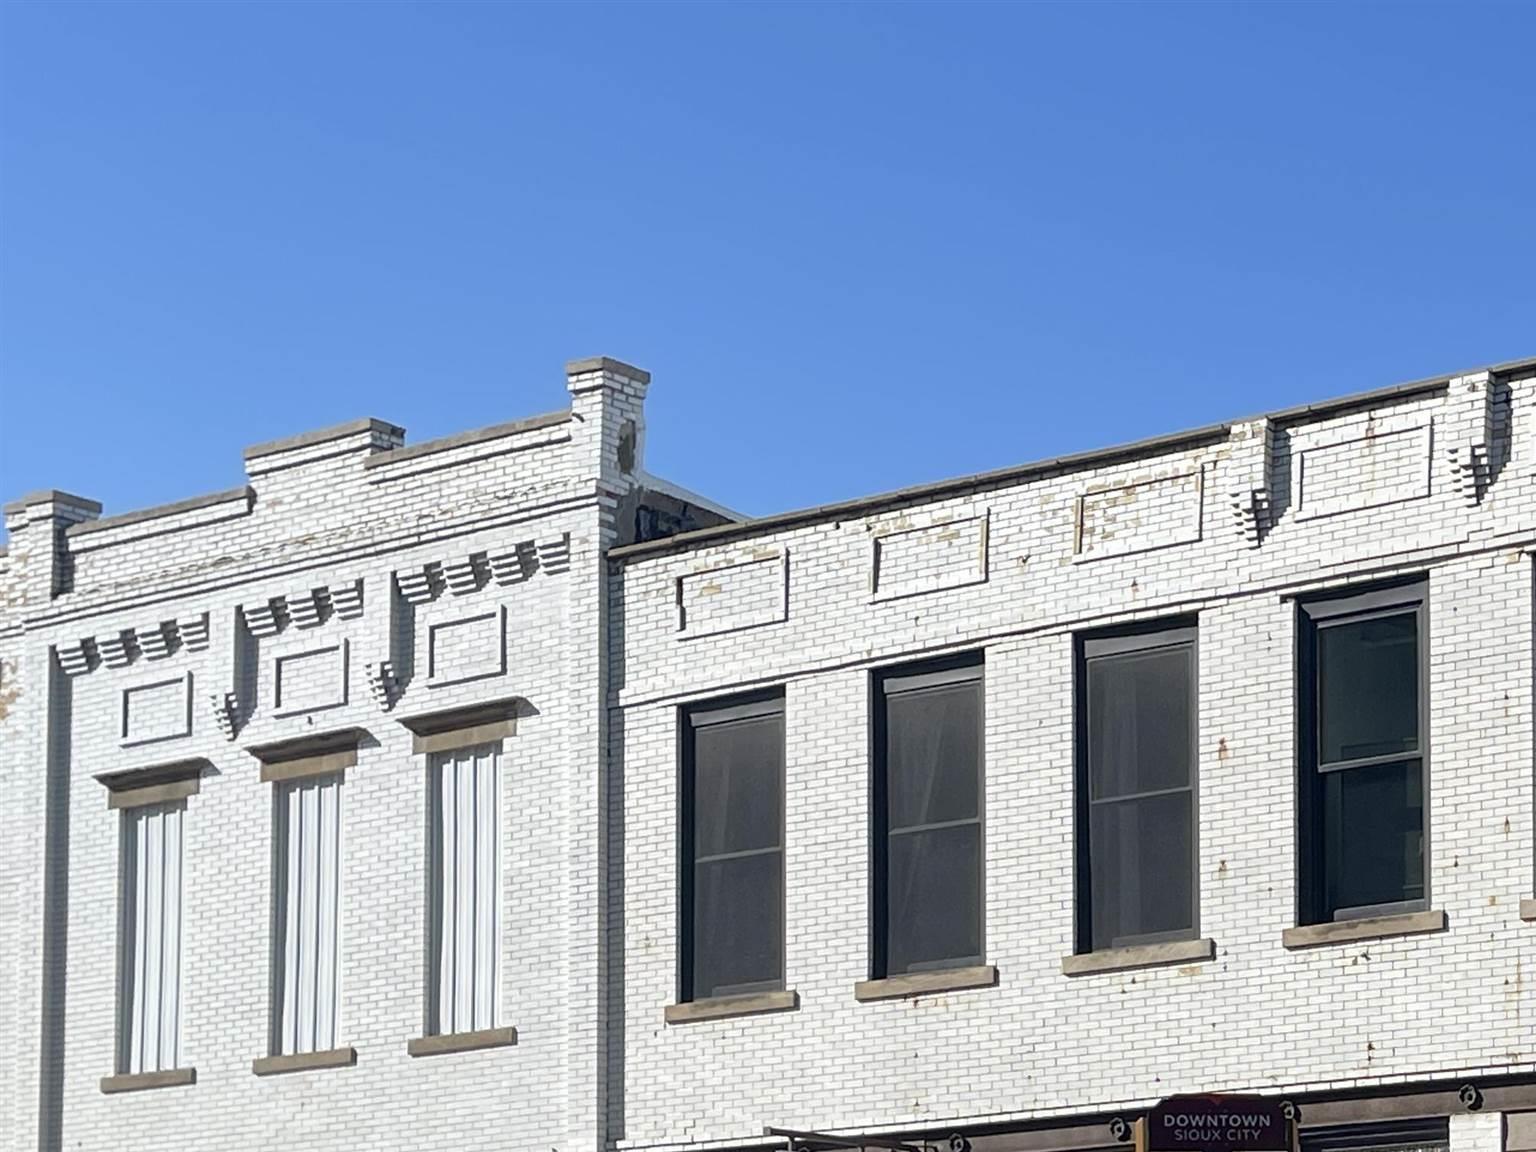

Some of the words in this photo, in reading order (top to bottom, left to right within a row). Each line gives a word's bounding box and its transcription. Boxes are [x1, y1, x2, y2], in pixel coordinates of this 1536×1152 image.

[1163, 1114, 1271, 1127] DOWNTOWN
[1174, 1128, 1222, 1141] SIOUX
[1226, 1128, 1262, 1141] CITY
